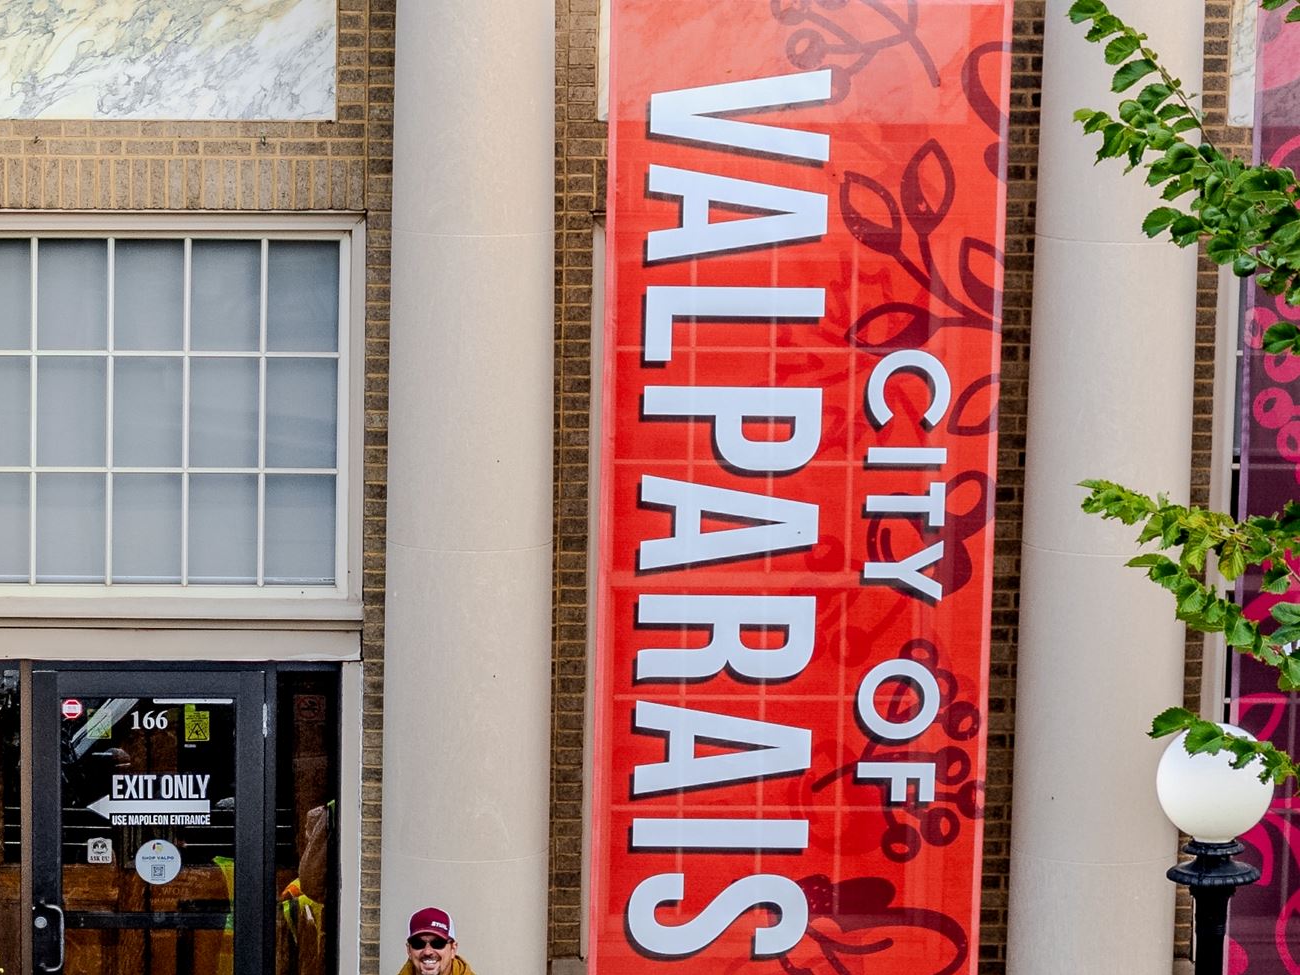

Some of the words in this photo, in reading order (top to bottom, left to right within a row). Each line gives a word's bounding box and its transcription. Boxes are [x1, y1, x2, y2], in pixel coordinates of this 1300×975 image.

[864, 349, 951, 601] CITY
[130, 710, 168, 730] 166
[856, 658, 940, 802] OF
[112, 775, 156, 799] EXIT
[161, 775, 210, 799] ONLY
[112, 815, 127, 825] USE
[129, 815, 169, 825] NAPOLEON
[170, 815, 211, 825] ENTRANCE
